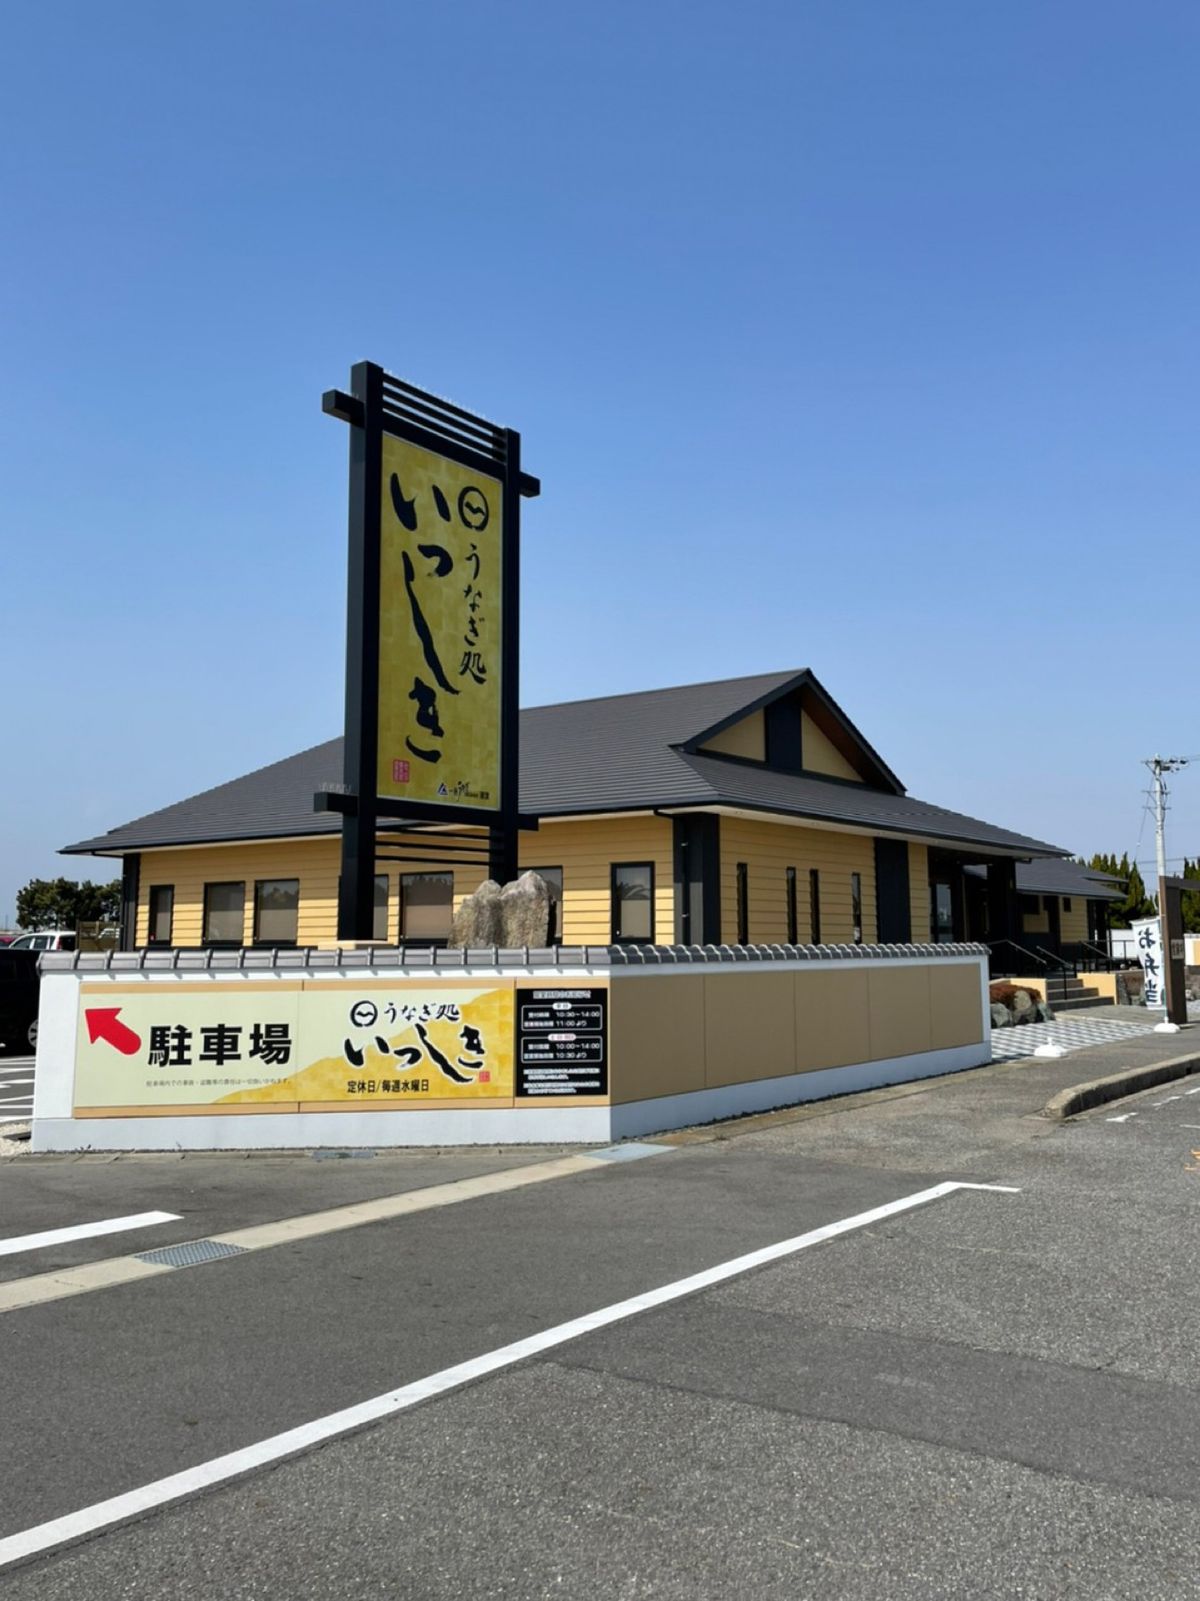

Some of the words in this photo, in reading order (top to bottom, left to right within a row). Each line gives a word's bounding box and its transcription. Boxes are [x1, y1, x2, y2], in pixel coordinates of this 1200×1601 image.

[459, 543, 488, 685] うなぎ処
[384, 1001, 461, 1024] うなぎ処
[147, 1023, 293, 1068] 駐車場
[346, 1079, 430, 1094] 定休日/毎週水曜日
